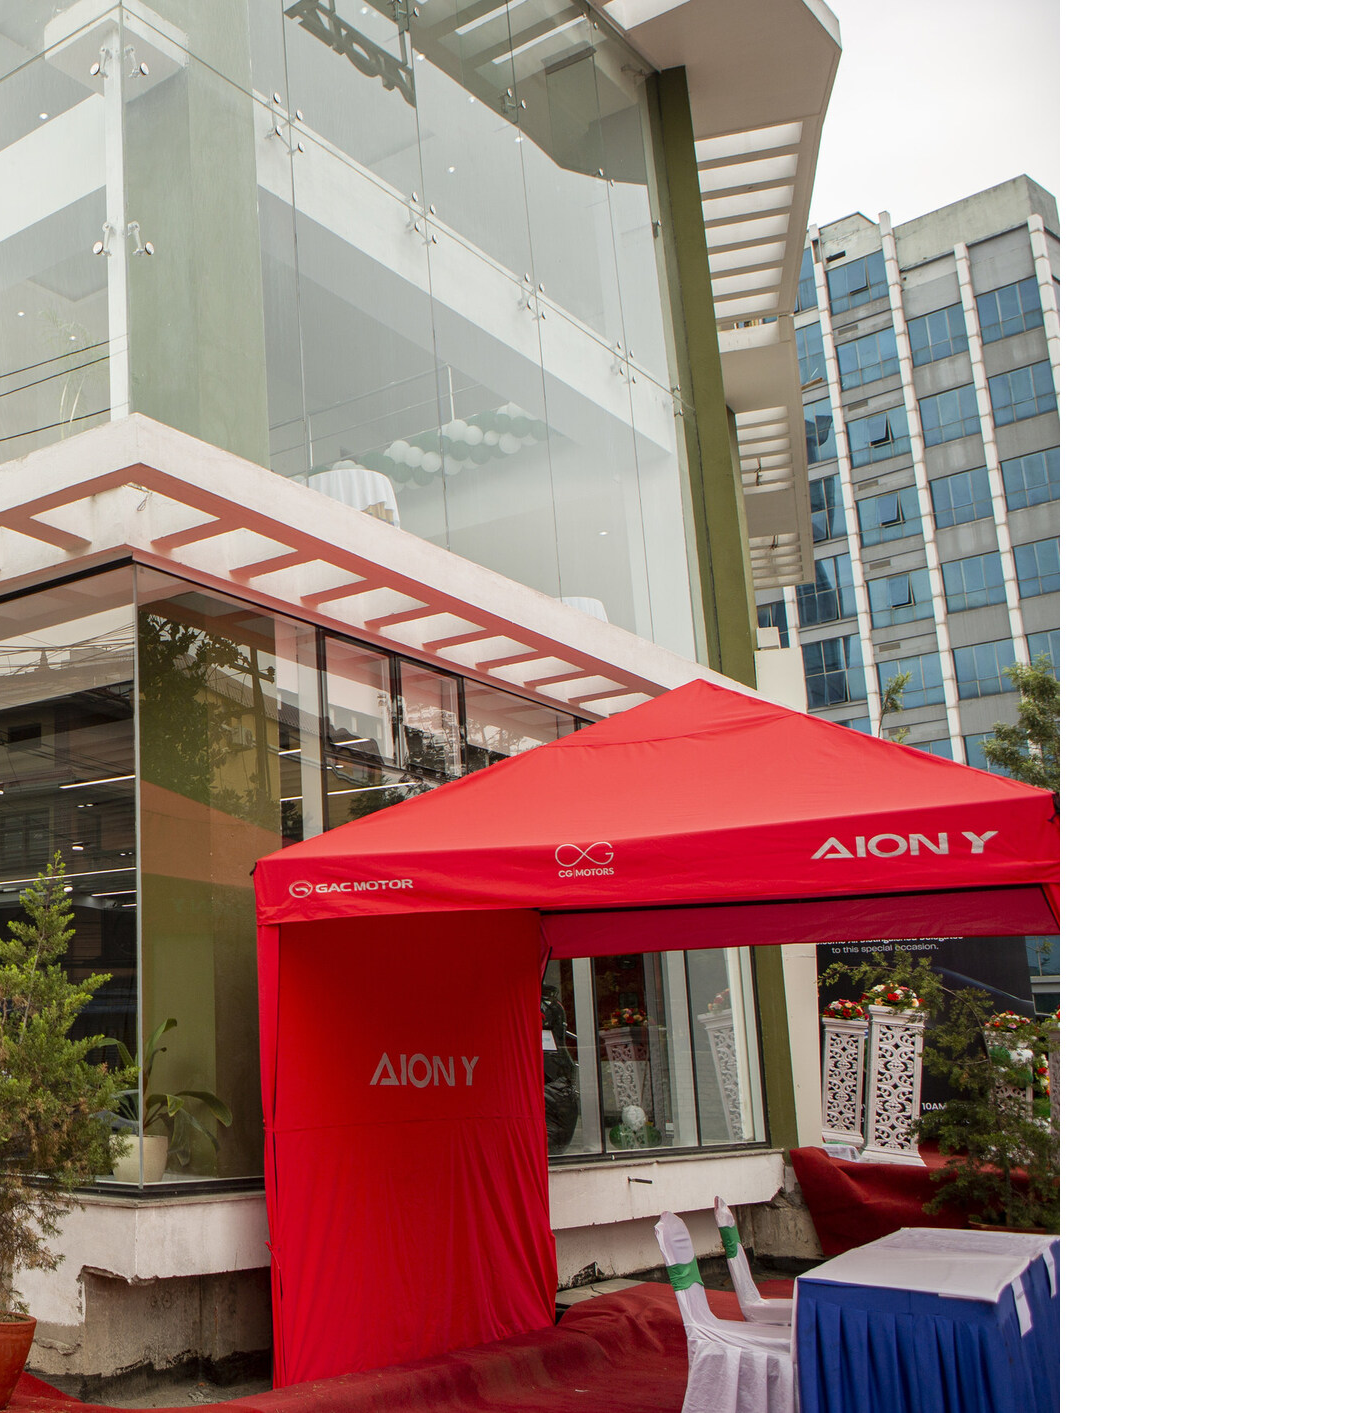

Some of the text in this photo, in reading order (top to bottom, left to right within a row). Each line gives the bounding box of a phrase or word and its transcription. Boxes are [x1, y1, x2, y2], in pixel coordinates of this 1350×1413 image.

[810, 830, 999, 860] AION Y
[575, 867, 615, 877] MOTORS
[315, 879, 414, 894] GAC MOTOR
[861, 944, 893, 953] special
[894, 943, 939, 951] occasion.
[370, 1052, 480, 1088] AION Y
